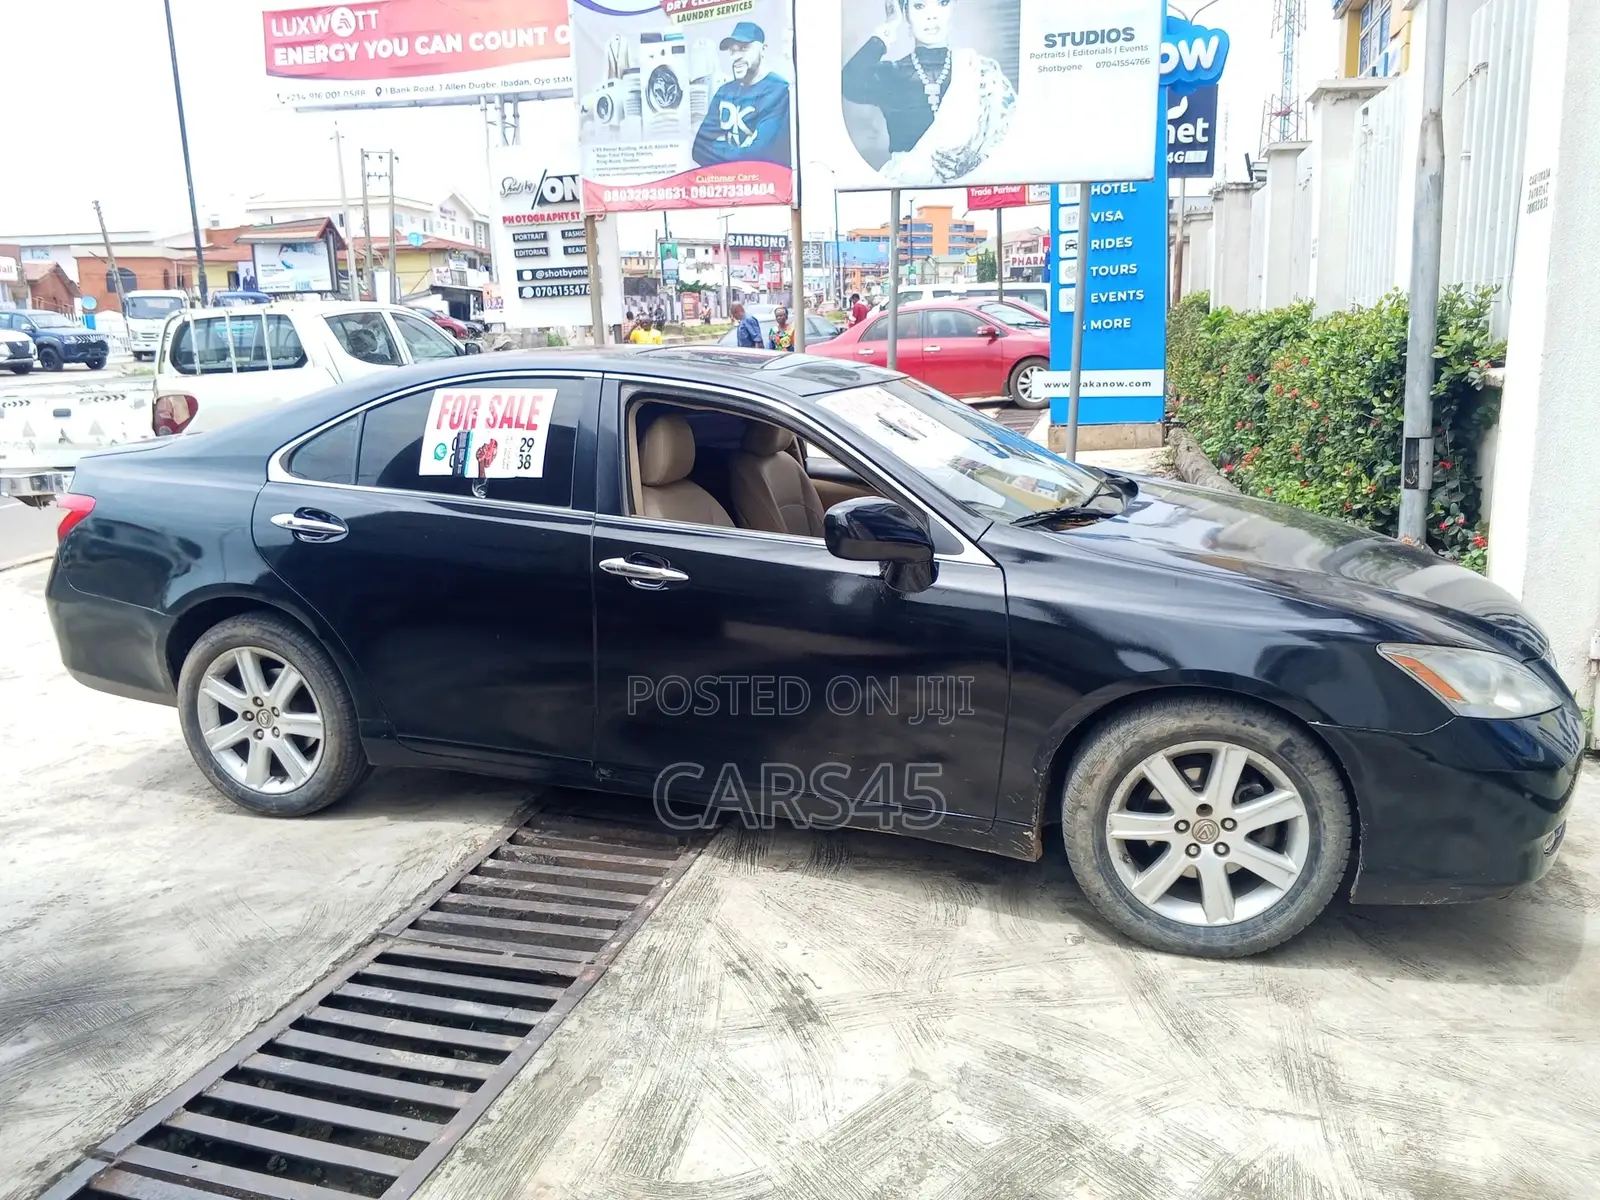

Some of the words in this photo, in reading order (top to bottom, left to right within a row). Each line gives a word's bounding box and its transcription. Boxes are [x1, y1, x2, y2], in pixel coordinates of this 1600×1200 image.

[677, 9, 715, 23] LAUNDRY
[716, 1, 753, 15] SERVICES
[1044, 27, 1135, 48] STUDIOS
[274, 41, 359, 67] ENERGY
[364, 36, 409, 58] YOU
[414, 32, 463, 56] CAN
[468, 26, 548, 51] COUNT
[554, 24, 571, 44] O
[1029, 50, 1066, 60] Portraits
[1072, 47, 1112, 57] Editorials
[1119, 44, 1149, 54] Events
[1038, 63, 1083, 73] Shotbyone
[1095, 57, 1151, 69] 07041554766
[390, 87, 411, 95] Bank
[534, 76, 551, 85] Oyo
[696, 174, 737, 183] Customer
[738, 172, 760, 181] Care:
[1091, 182, 1136, 196] HOTEL
[502, 213, 569, 224] PHOTOGRAPHY
[1091, 210, 1124, 222] VISA
[514, 233, 545, 241] PORTRAIT
[729, 235, 786, 248] SAMSUNG
[1091, 237, 1133, 249] RIDES
[515, 248, 547, 257] EDITORIAL
[535, 268, 588, 279] @shotbyone
[1091, 263, 1137, 276] TOURS
[535, 284, 591, 297] 0704155476
[1091, 289, 1145, 303] EVENTS
[1091, 317, 1131, 330] MORE
[436, 395, 481, 430] FOR
[485, 394, 543, 430] SALE
